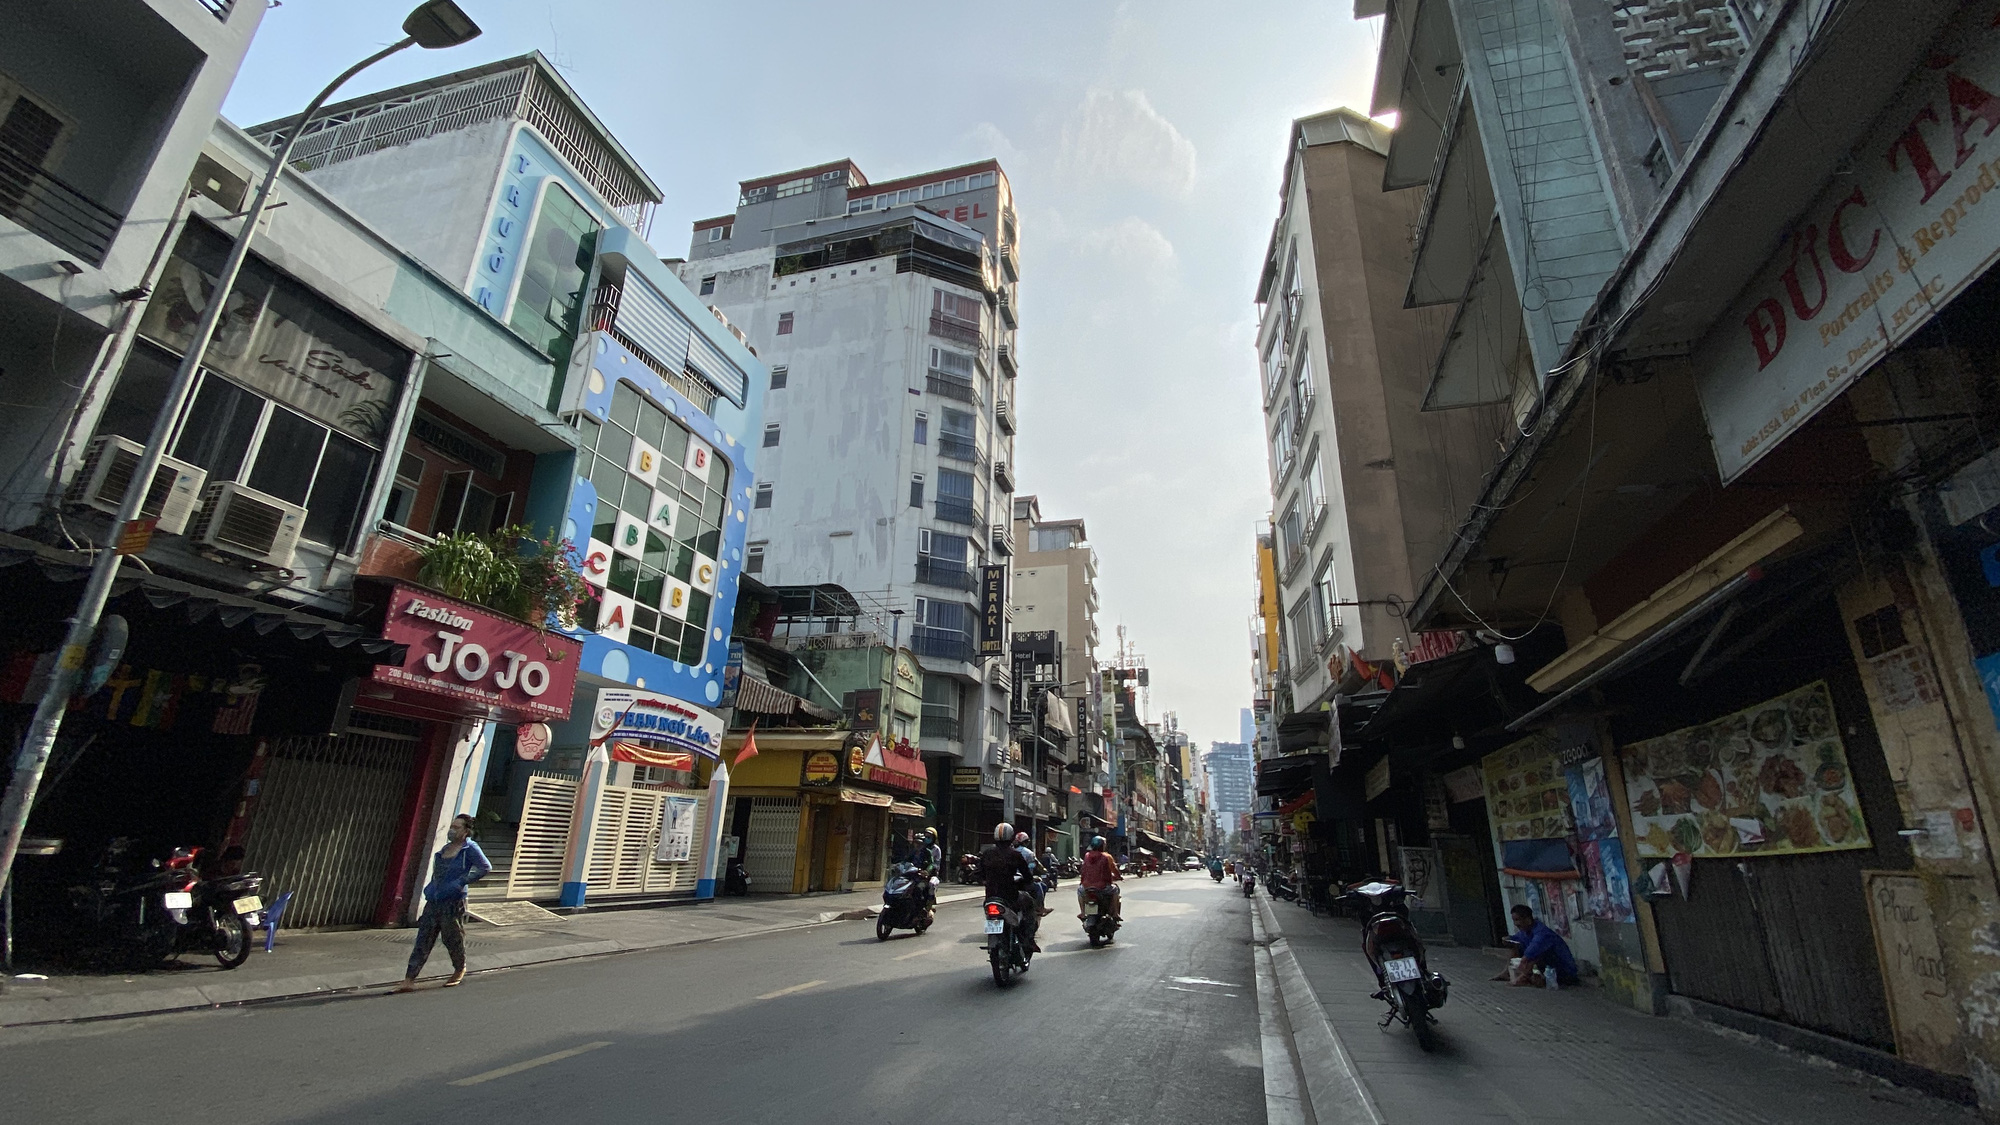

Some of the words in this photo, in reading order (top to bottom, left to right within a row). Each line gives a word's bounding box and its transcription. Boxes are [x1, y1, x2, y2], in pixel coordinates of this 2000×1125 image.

[640, 450, 652, 472] B
[696, 448, 706, 467] B
[657, 504, 671, 526] A
[626, 524, 639, 546] B
[588, 552, 607, 575] C
[698, 564, 712, 584] C
[672, 587, 683, 608] B
[987, 569, 1000, 638] MERAKI
[403, 598, 475, 632] Fashion
[608, 605, 625, 629] A
[981, 640, 1001, 651] HOTEL
[1014, 652, 1032, 660] Hotel
